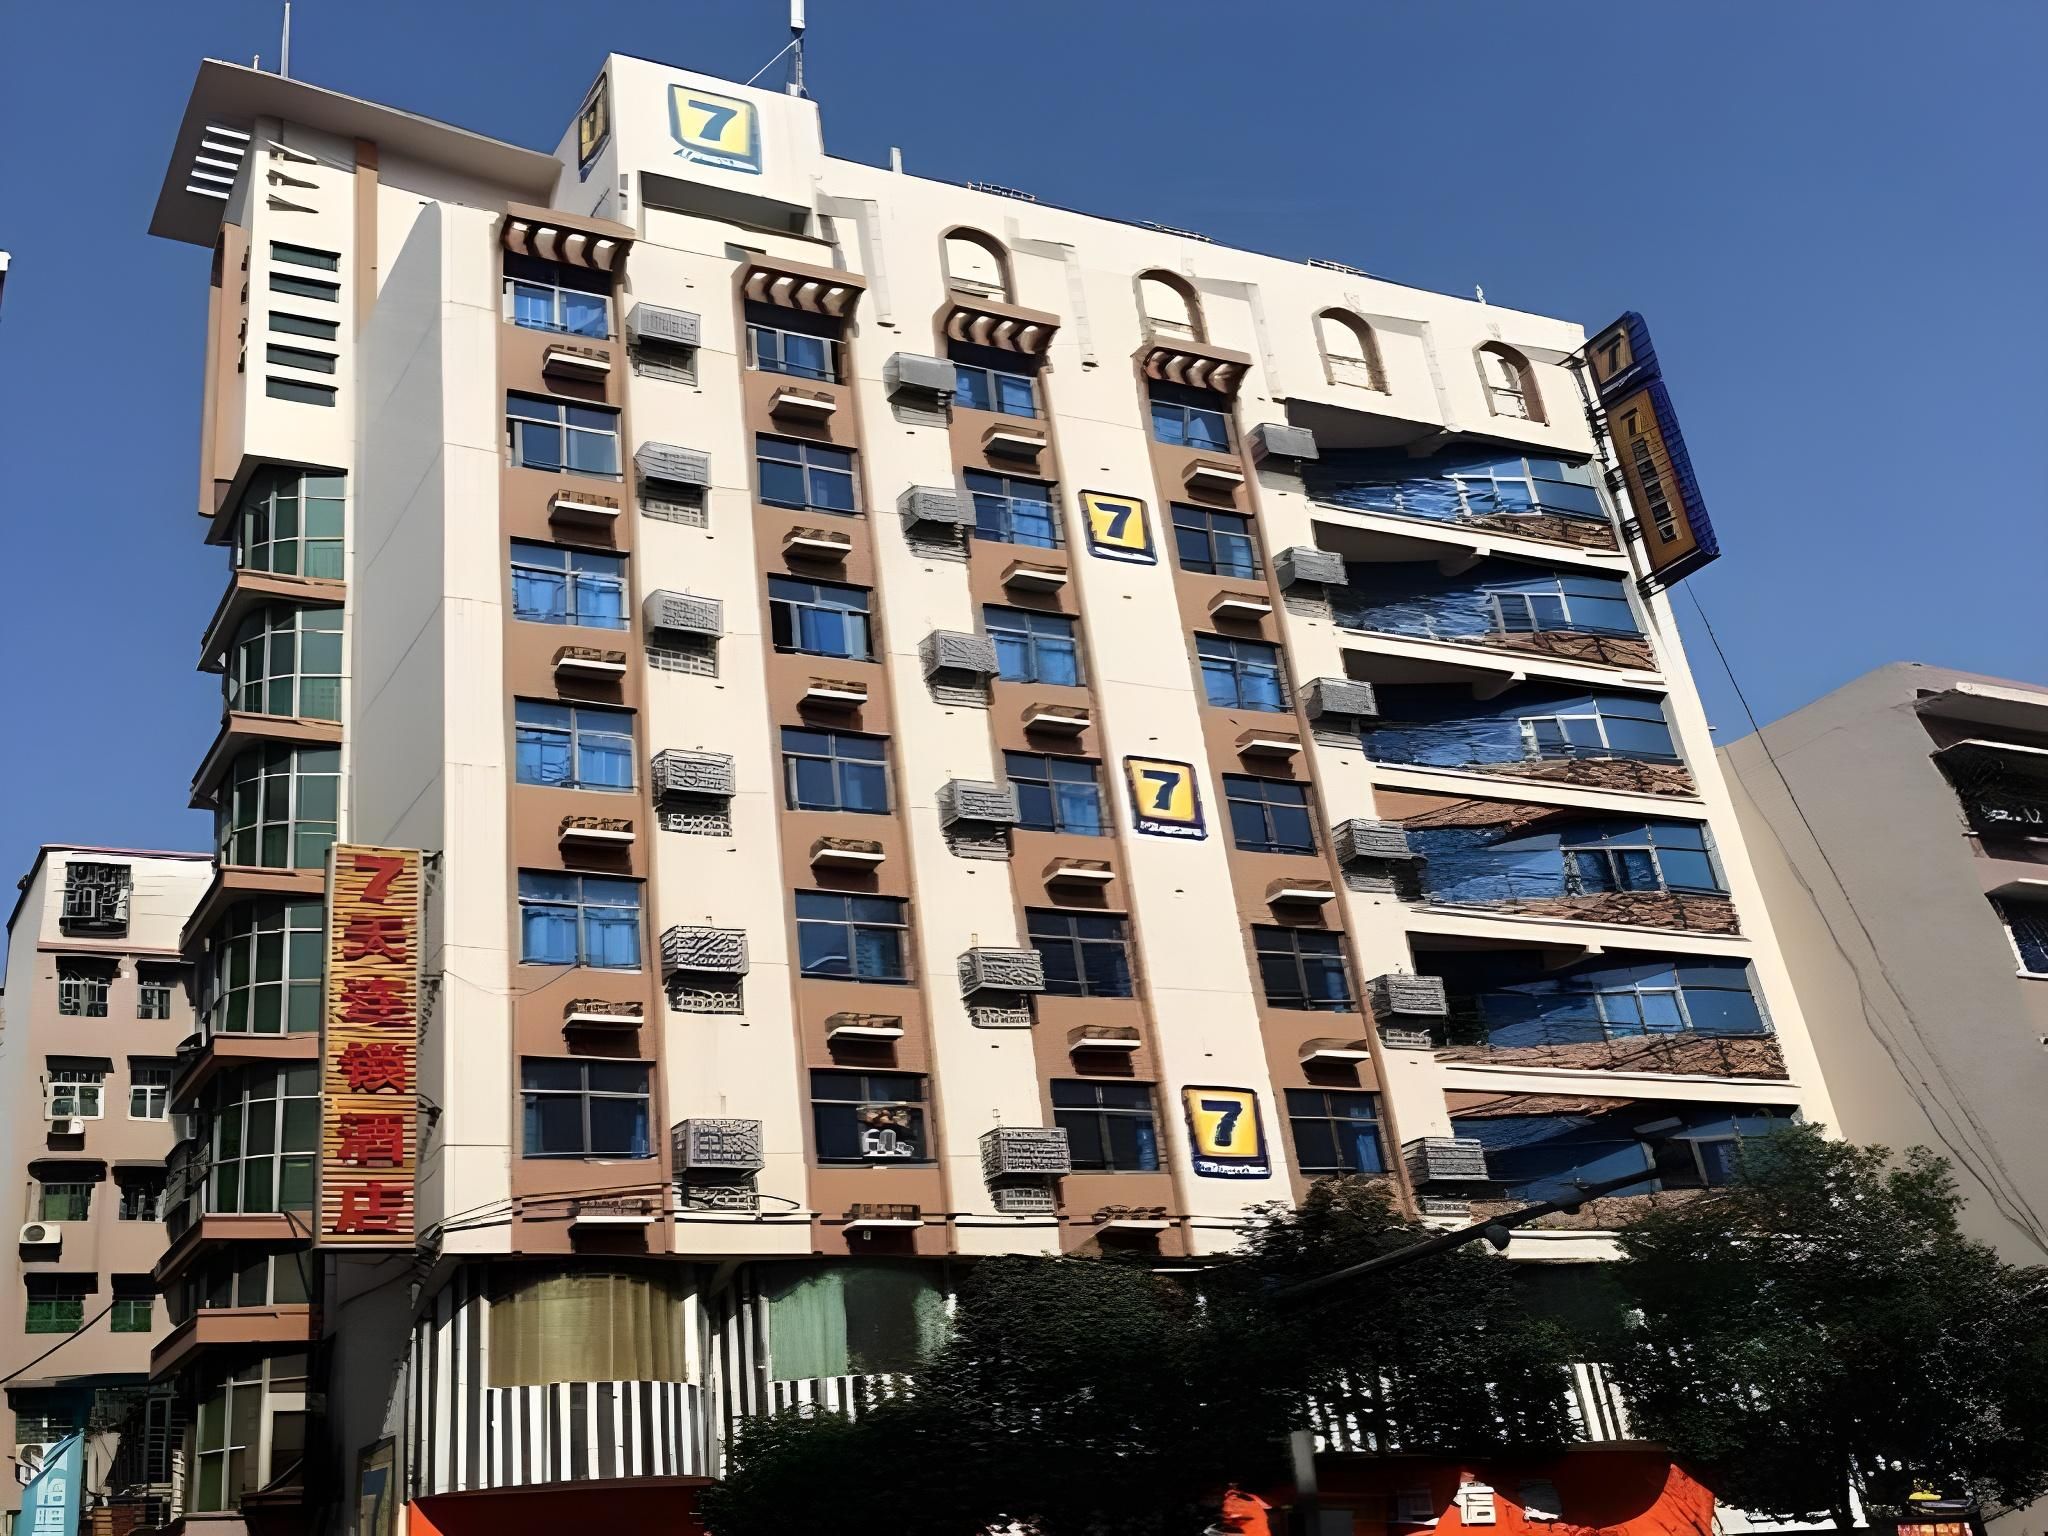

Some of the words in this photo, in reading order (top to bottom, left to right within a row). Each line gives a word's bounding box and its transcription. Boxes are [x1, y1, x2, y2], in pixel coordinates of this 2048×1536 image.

[689, 99, 738, 141] 7
[1094, 502, 1132, 539] 7
[1141, 769, 1180, 810] 7
[1201, 1100, 1242, 1146] 7
